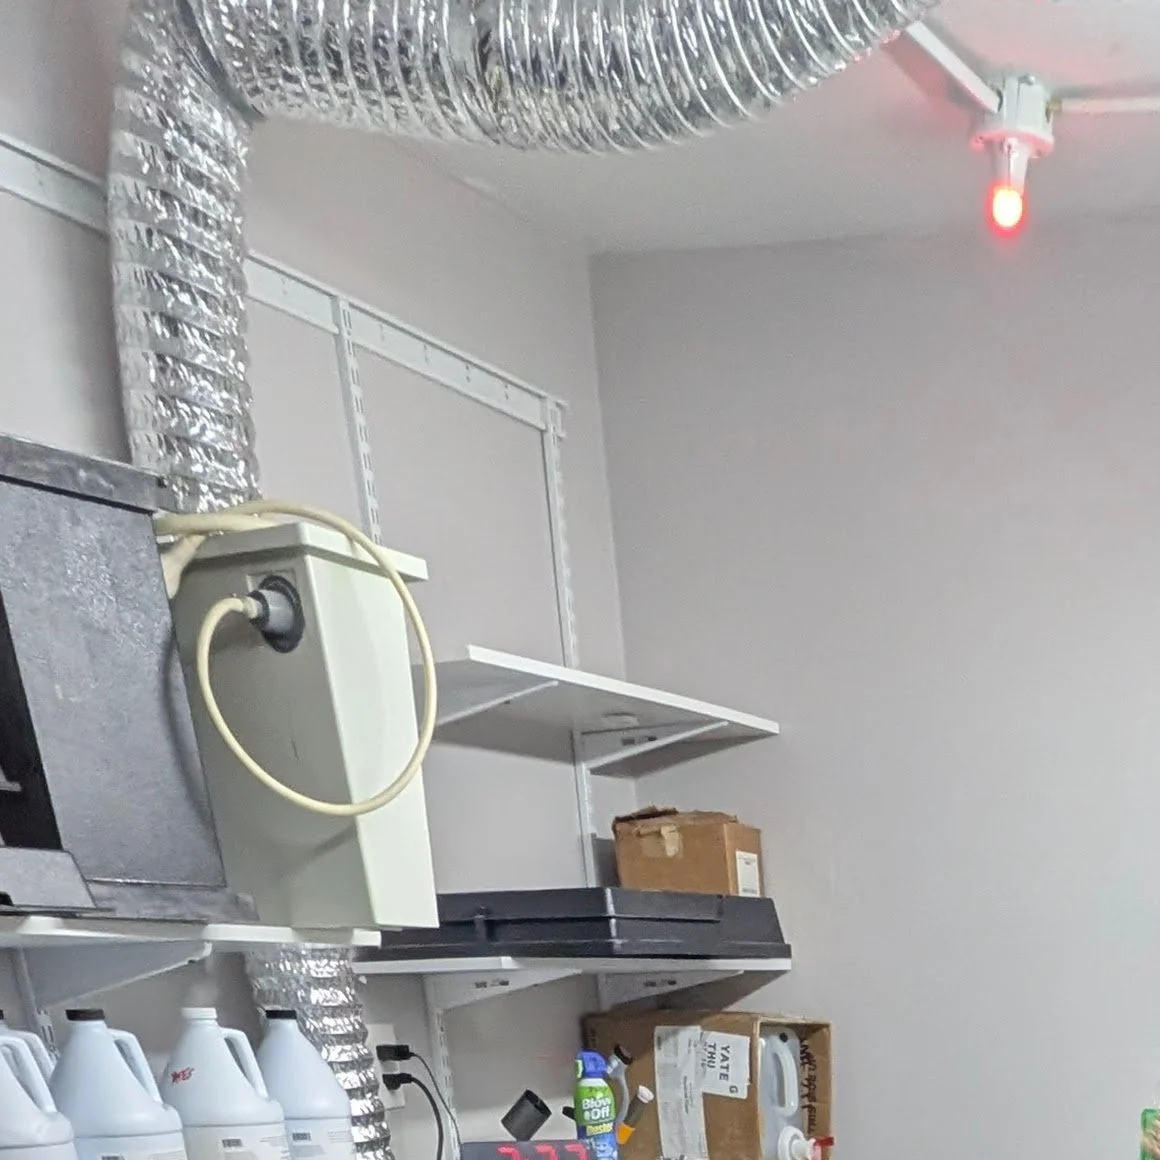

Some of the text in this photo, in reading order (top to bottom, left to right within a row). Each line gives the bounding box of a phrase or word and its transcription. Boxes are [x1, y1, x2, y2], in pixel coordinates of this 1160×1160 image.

[706, 1042, 717, 1069] THU
[719, 1045, 731, 1081] YATE
[729, 1084, 739, 1094] G
[582, 1097, 611, 1111] Blow
[591, 1105, 610, 1120] Off
